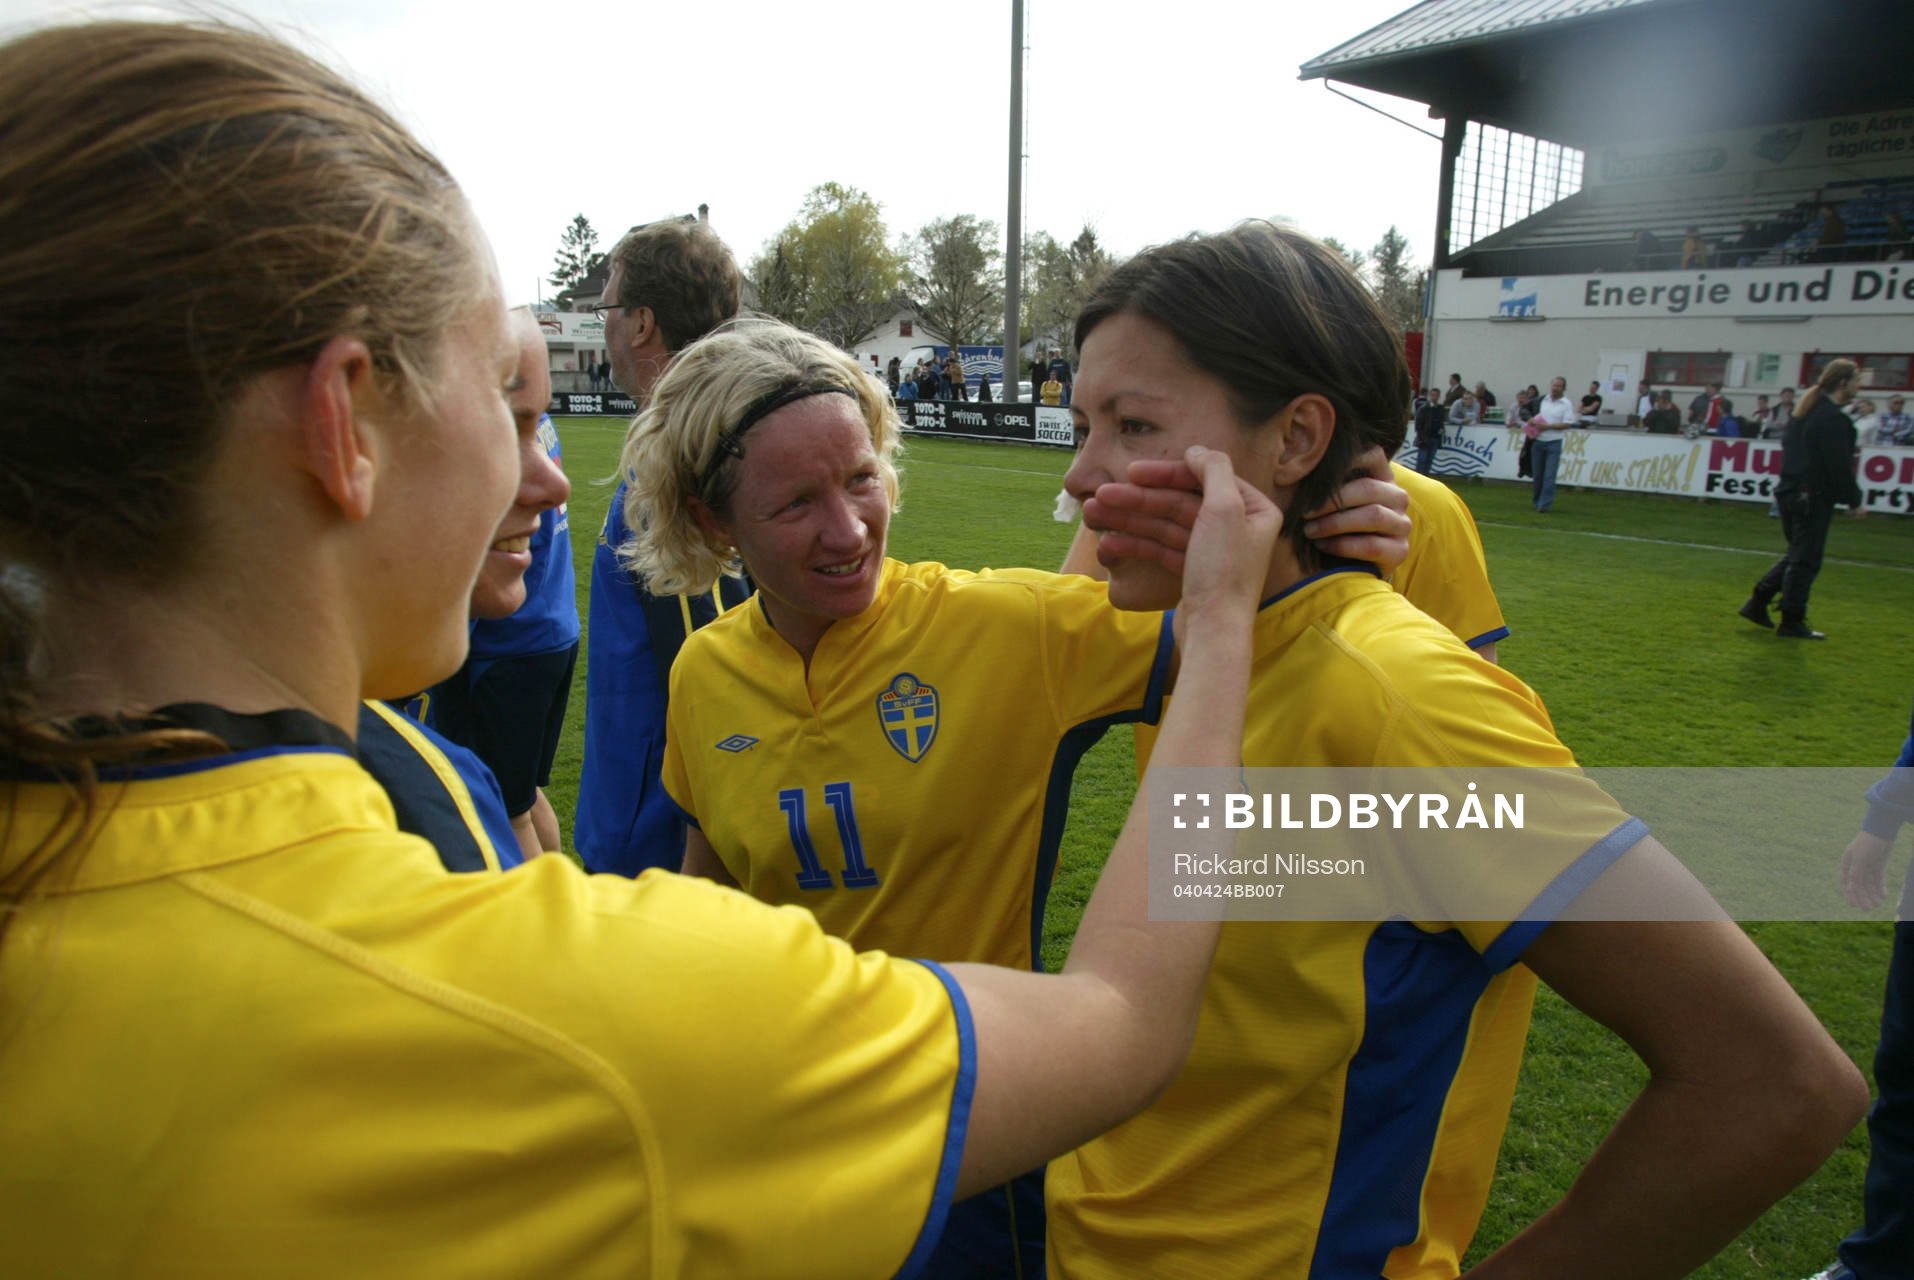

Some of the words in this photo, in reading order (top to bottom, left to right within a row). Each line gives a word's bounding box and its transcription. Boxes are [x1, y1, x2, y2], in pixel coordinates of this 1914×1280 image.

[1584, 273, 1731, 314] Energie
[1747, 267, 1834, 303] und
[568, 394, 603, 403] TOTO-R
[568, 404, 603, 413] TOTO-X
[913, 402, 946, 415] TOTO-R
[914, 415, 947, 428] TOTO-X
[1004, 414, 1031, 427] OPEL
[1037, 429, 1071, 441] SOCCER
[1590, 460, 1624, 486] UNS
[1625, 443, 1702, 492] STARK!
[1705, 473, 1773, 497] Fest
[778, 781, 881, 890] 11
